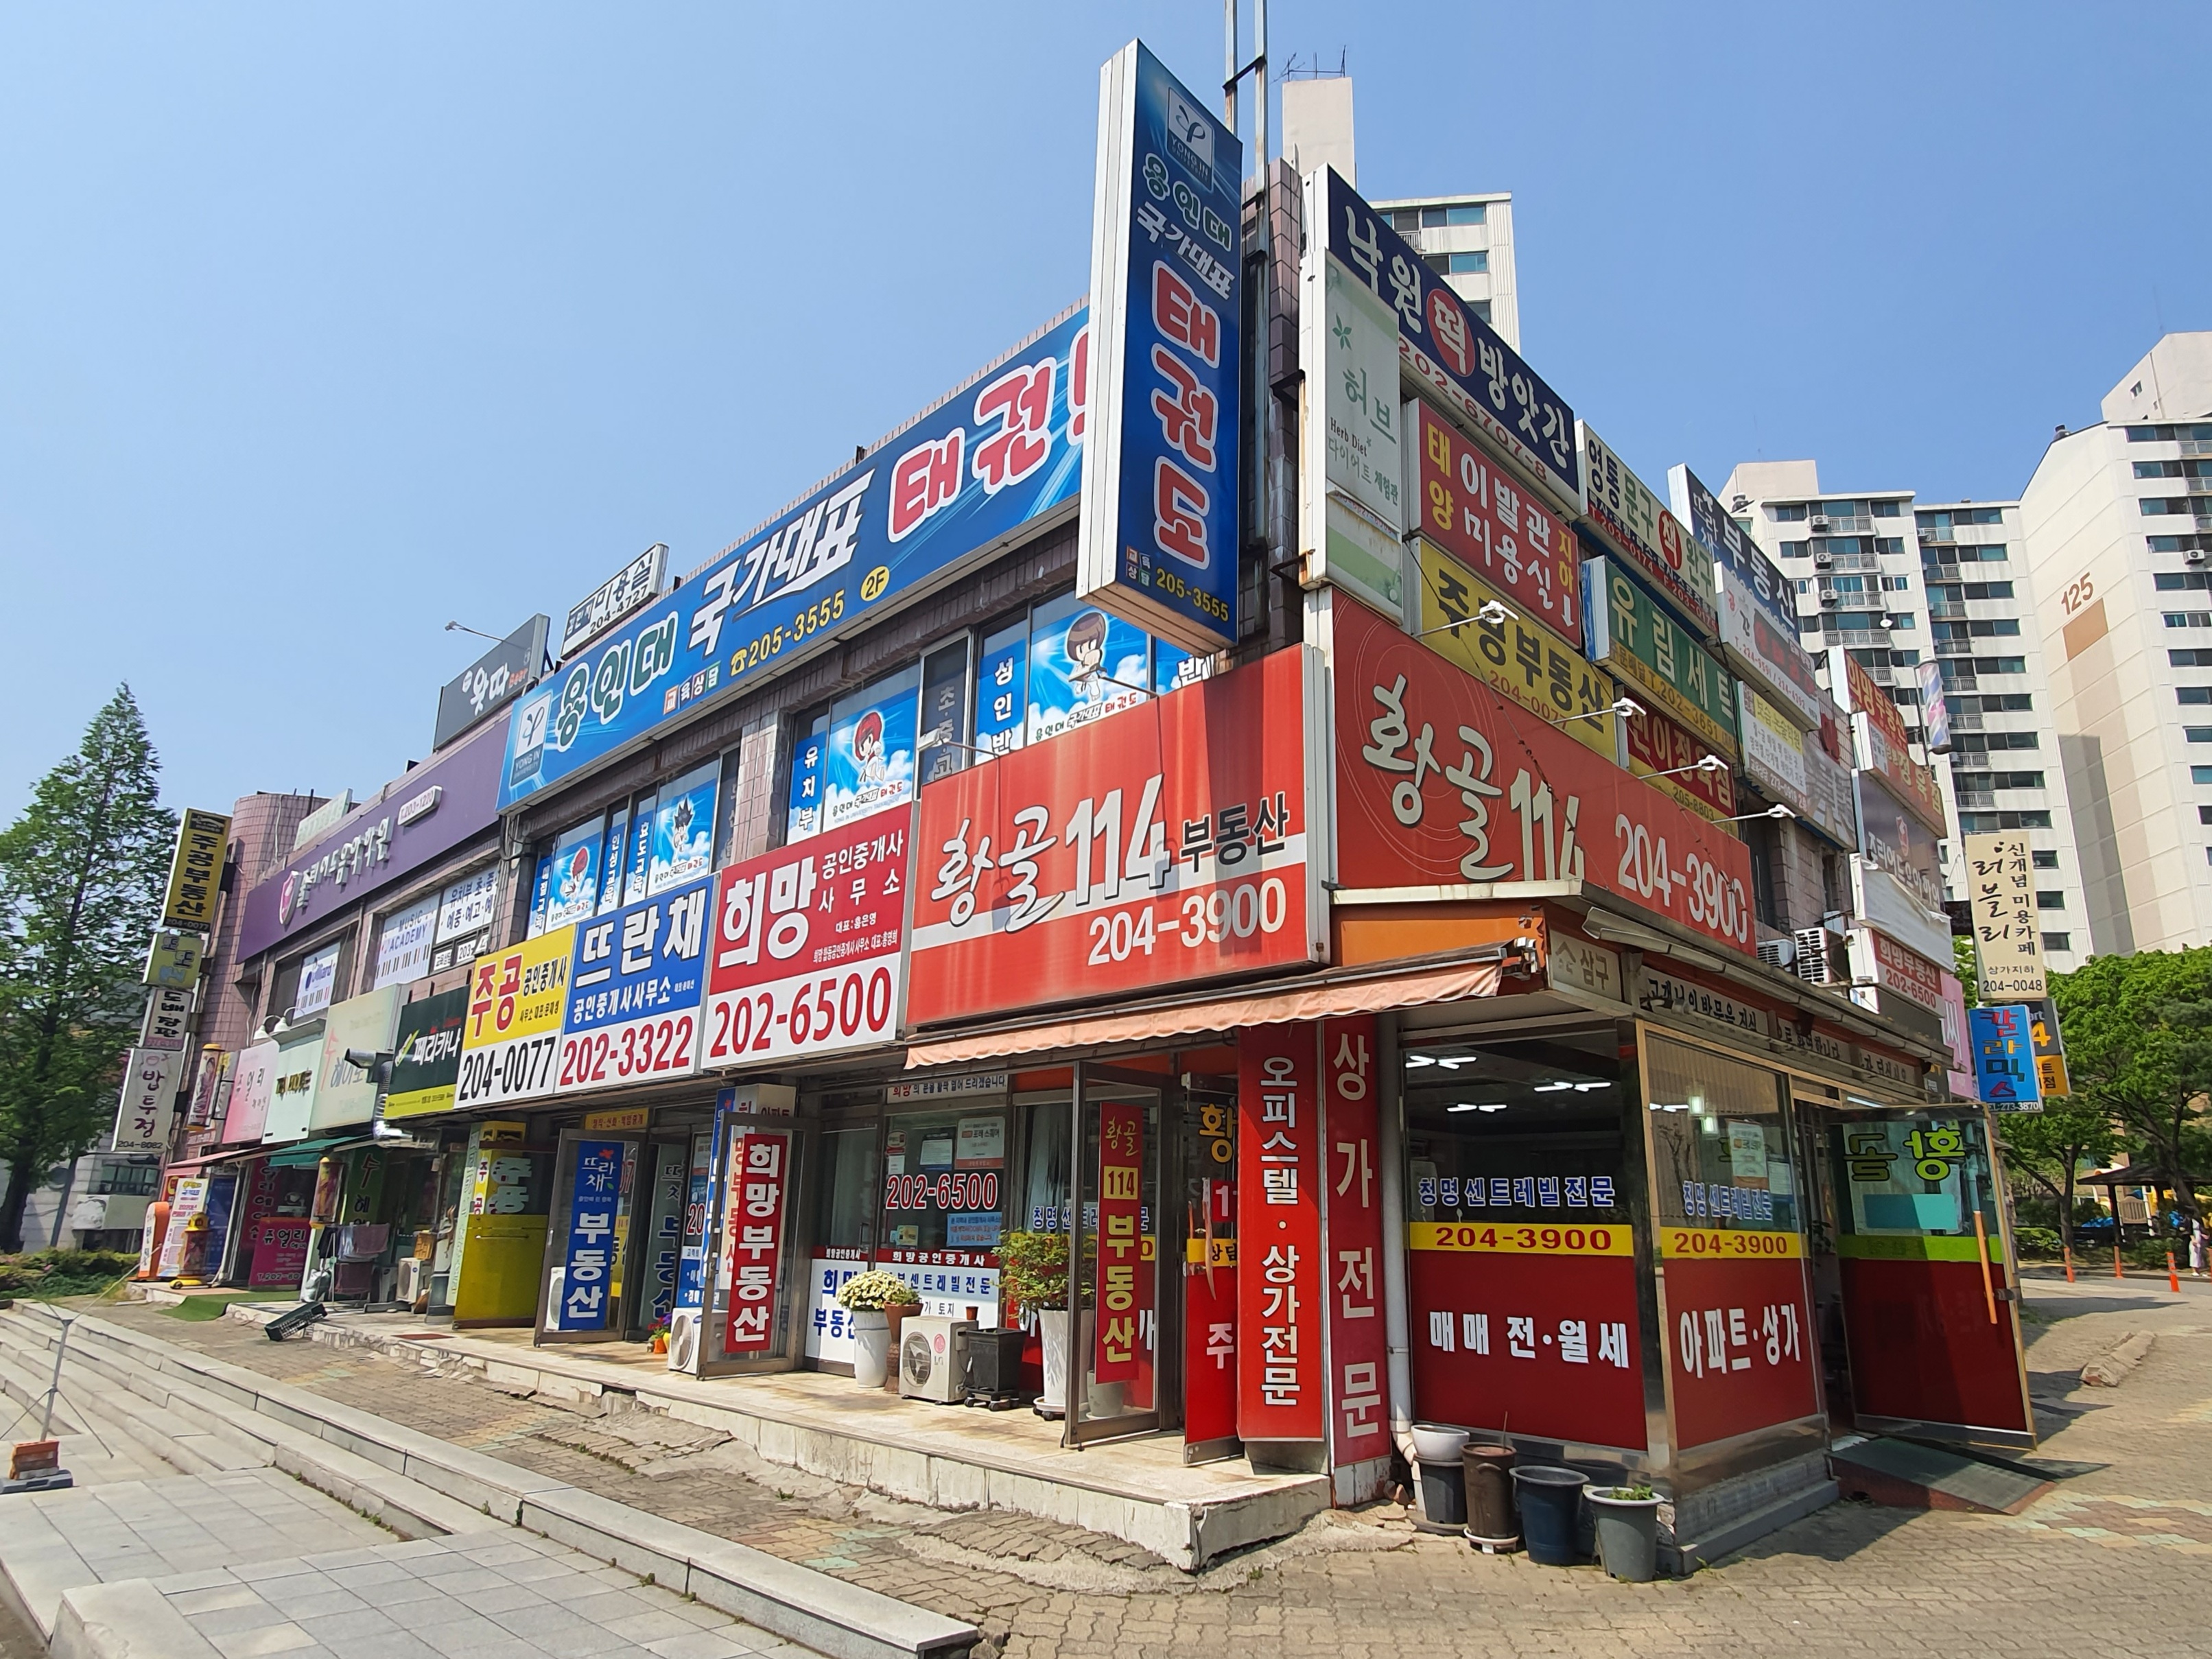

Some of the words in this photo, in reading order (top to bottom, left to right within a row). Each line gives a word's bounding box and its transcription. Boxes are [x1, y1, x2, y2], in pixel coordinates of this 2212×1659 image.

[1142, 152, 1232, 252] 용인대
[1136, 202, 1235, 301] 국가대표
[889, 325, 1086, 543] 태권
[1151, 259, 1221, 570] 태권도
[1343, 367, 1397, 445] 허브
[1328, 436, 1372, 484] 다이어트
[1330, 417, 1350, 448] Herb
[1352, 433, 1368, 458] Diet
[1427, 421, 1454, 531] 태양
[1461, 453, 1551, 558] 이발관
[596, 552, 653, 610] 미용실
[688, 469, 875, 657] 국가대표
[1464, 506, 1554, 610] 미용실
[1558, 528, 1574, 594] 지하
[1686, 537, 1713, 598] 완구
[1723, 515, 1796, 630] 부동산
[589, 585, 648, 635] 204-4727
[748, 589, 845, 667] 205-3555
[864, 569, 888, 600] 2F
[1156, 567, 1229, 623] 205-3555
[2061, 572, 2093, 615] 125
[555, 611, 679, 752] 용인대
[991, 657, 1013, 755] 성인반
[1490, 670, 1568, 730] 204-0077
[1035, 722, 1064, 742] 용인대
[1067, 703, 1103, 729] 국가대표
[1105, 692, 1138, 713] 태권도
[799, 744, 819, 830] 유치부
[832, 801, 854, 817] 용인대
[881, 781, 903, 798] 태권도
[1673, 786, 1715, 823] 205-8803
[1179, 790, 1290, 873] 부동산
[174, 833, 218, 918] 주공부동산
[2007, 843, 2028, 889] 신개념
[399, 909, 423, 932] MUSIC
[718, 855, 817, 968] 희망
[821, 829, 904, 881] 공인중개사
[1087, 877, 1287, 967] 204-3900
[1972, 858, 2008, 943] 러블리
[2012, 893, 2037, 956] 미용카페
[389, 923, 428, 952] ACADEMY
[575, 887, 707, 989] 뜨란채
[1879, 937, 1936, 989] 희망부동산
[471, 954, 523, 1038] 주공
[523, 956, 567, 997] 공인중개사
[1885, 968, 1937, 1009] 202-6500
[1983, 980, 2043, 993] 204-0048
[1988, 965, 2035, 975] 상가지하
[709, 966, 891, 1058] 202-6500
[412, 1028, 462, 1066] 페리카나
[458, 1036, 556, 1101] 204-0077
[560, 1015, 693, 1087] 202-3322
[1979, 1009, 2025, 1098] 칼라믹스
[134, 1069, 165, 1138] 밥투정
[1988, 1102, 2040, 1111] EL:273-3870
[1105, 1120, 1140, 1157] 황골
[582, 1156, 616, 1192] 뜨란채
[885, 1173, 998, 1210] 202-6500
[1107, 1170, 1136, 1196] 114
[1418, 1177, 1459, 1207] 청명
[1466, 1177, 1560, 1208] 센트레빌
[1564, 1176, 1615, 1208] 전문
[1683, 1179, 1706, 1217] 청명
[733, 1144, 781, 1343] 희망부동산
[1033, 1205, 1057, 1229] 청명
[1435, 1227, 1612, 1251] 204-3900
[1674, 1232, 1788, 1255] 204-3900
[567, 1212, 611, 1318] 부동산
[892, 1251, 986, 1267] 희망공인중개사
[1102, 1214, 1136, 1363] 부동산
[938, 1302, 954, 1317] 토지
[1429, 1311, 1491, 1356] 매매
